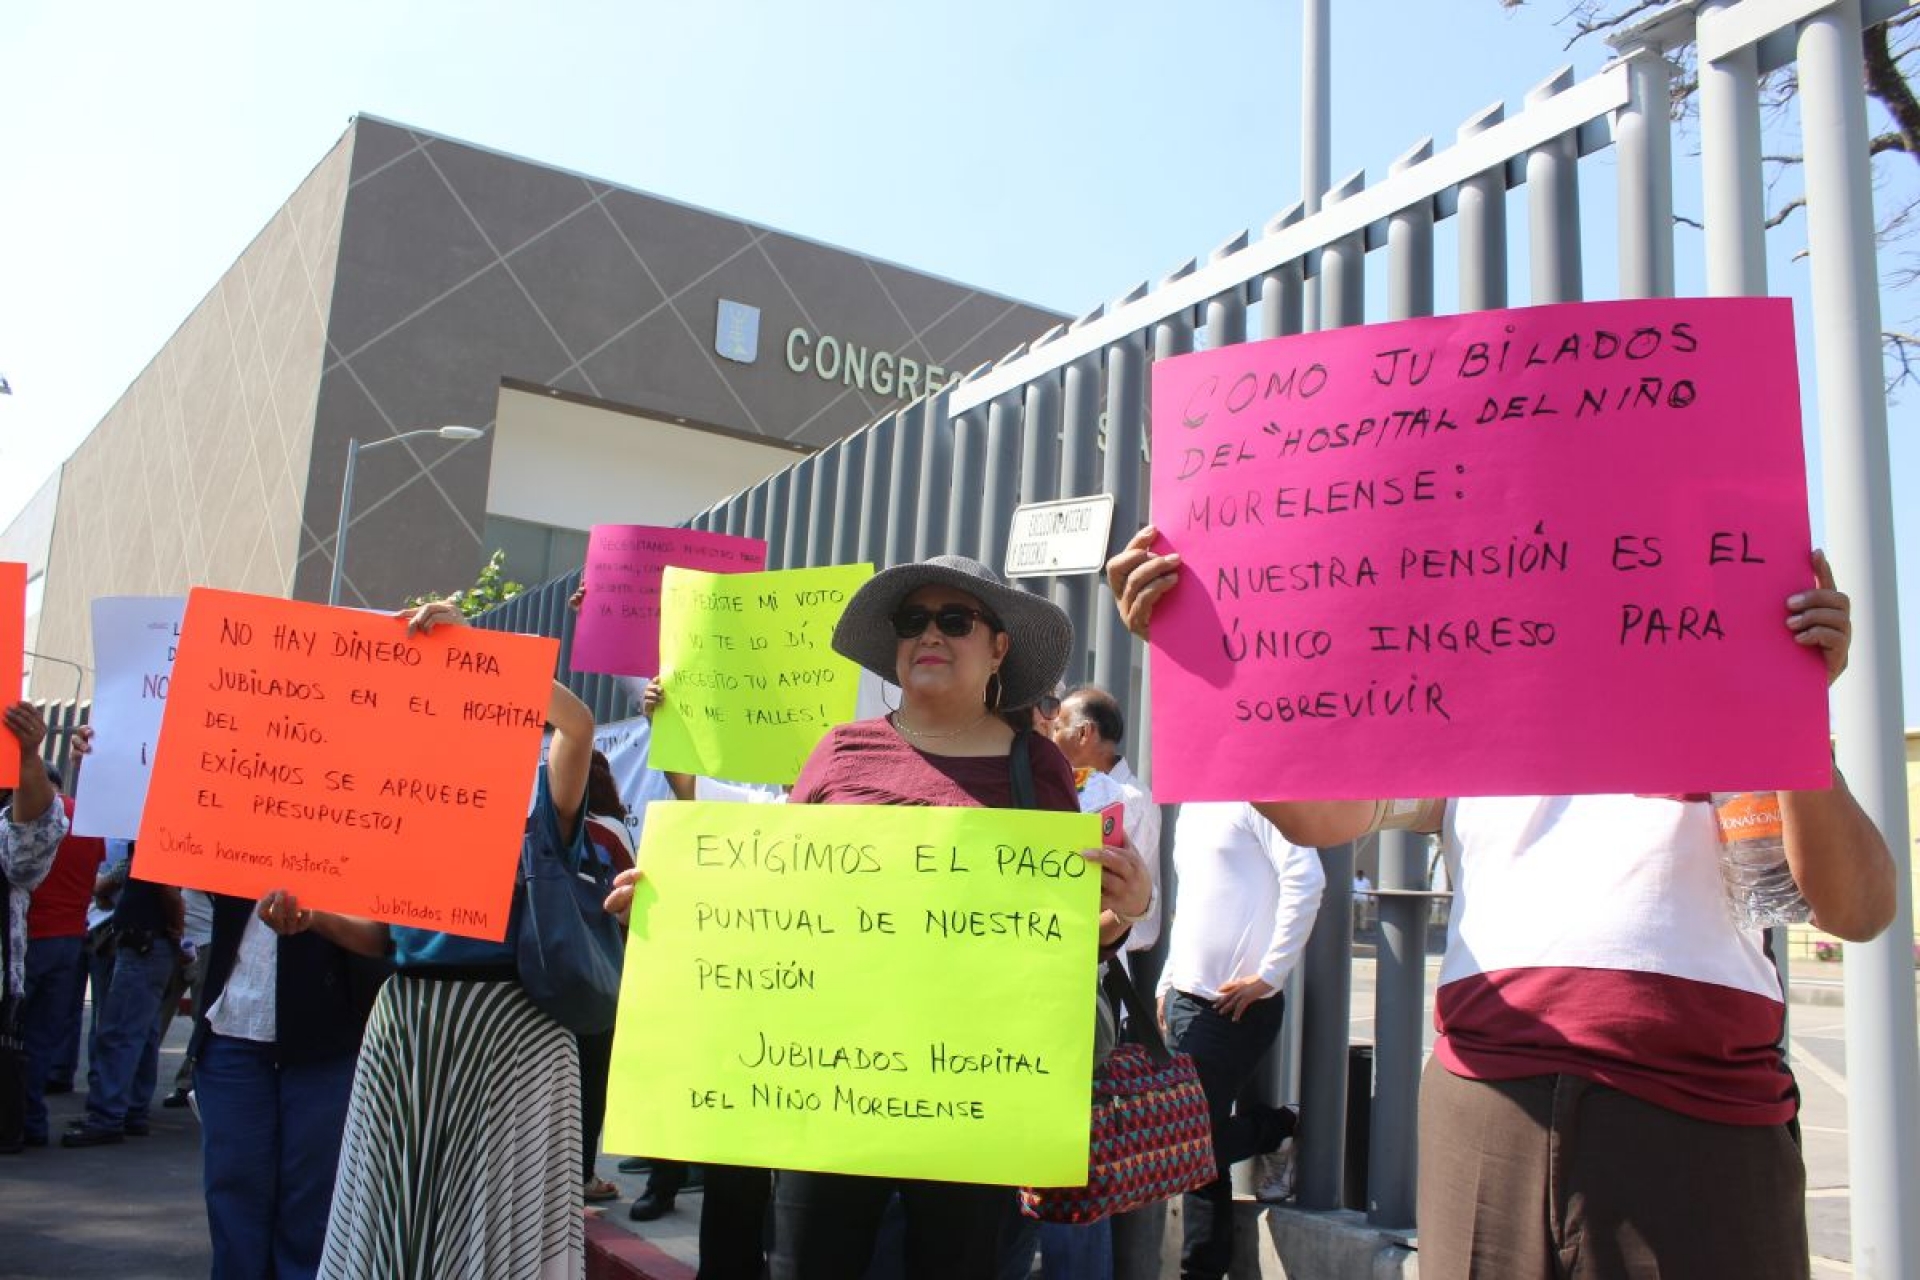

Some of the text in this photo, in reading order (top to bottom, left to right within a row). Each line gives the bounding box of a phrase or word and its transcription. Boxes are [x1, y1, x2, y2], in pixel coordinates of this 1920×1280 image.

[1183, 362, 1328, 429] COMO
[1177, 438, 1256, 481] DEL
[1475, 393, 1559, 425] DEL
[1575, 376, 1697, 419] NIÑO
[1217, 519, 1766, 601] NUESTRA PENSIÓN ES EL
[758, 591, 778, 612] MI
[796, 590, 843, 606] VOTO
[220, 617, 500, 677] NO HAY DINERO PARA
[712, 634, 734, 650] TE
[749, 636, 768, 650] LO
[1222, 603, 1727, 663] ÚNICO INGRESO PARA
[208, 667, 546, 729] JUBILADOS EN EL HOSPITAL
[744, 675, 767, 690] TU
[778, 668, 834, 687] APOYO
[1236, 673, 1451, 723] SOBREVIVIR
[204, 709, 239, 731] DEL
[705, 704, 727, 722] ME
[197, 789, 223, 809] EL
[200, 748, 488, 809] EXIGIMOS SE APRUEBE
[215, 841, 273, 868] haremos
[697, 829, 1087, 879] EXIGIMOS EL PAGO
[696, 901, 1063, 942] PUNTUAL DE NUESTRA
[695, 957, 815, 991] PENSIÓN
[738, 1031, 909, 1072] JUBILADOS
[689, 1087, 735, 1109] DEL
[834, 1084, 985, 1119] MORELENSE
